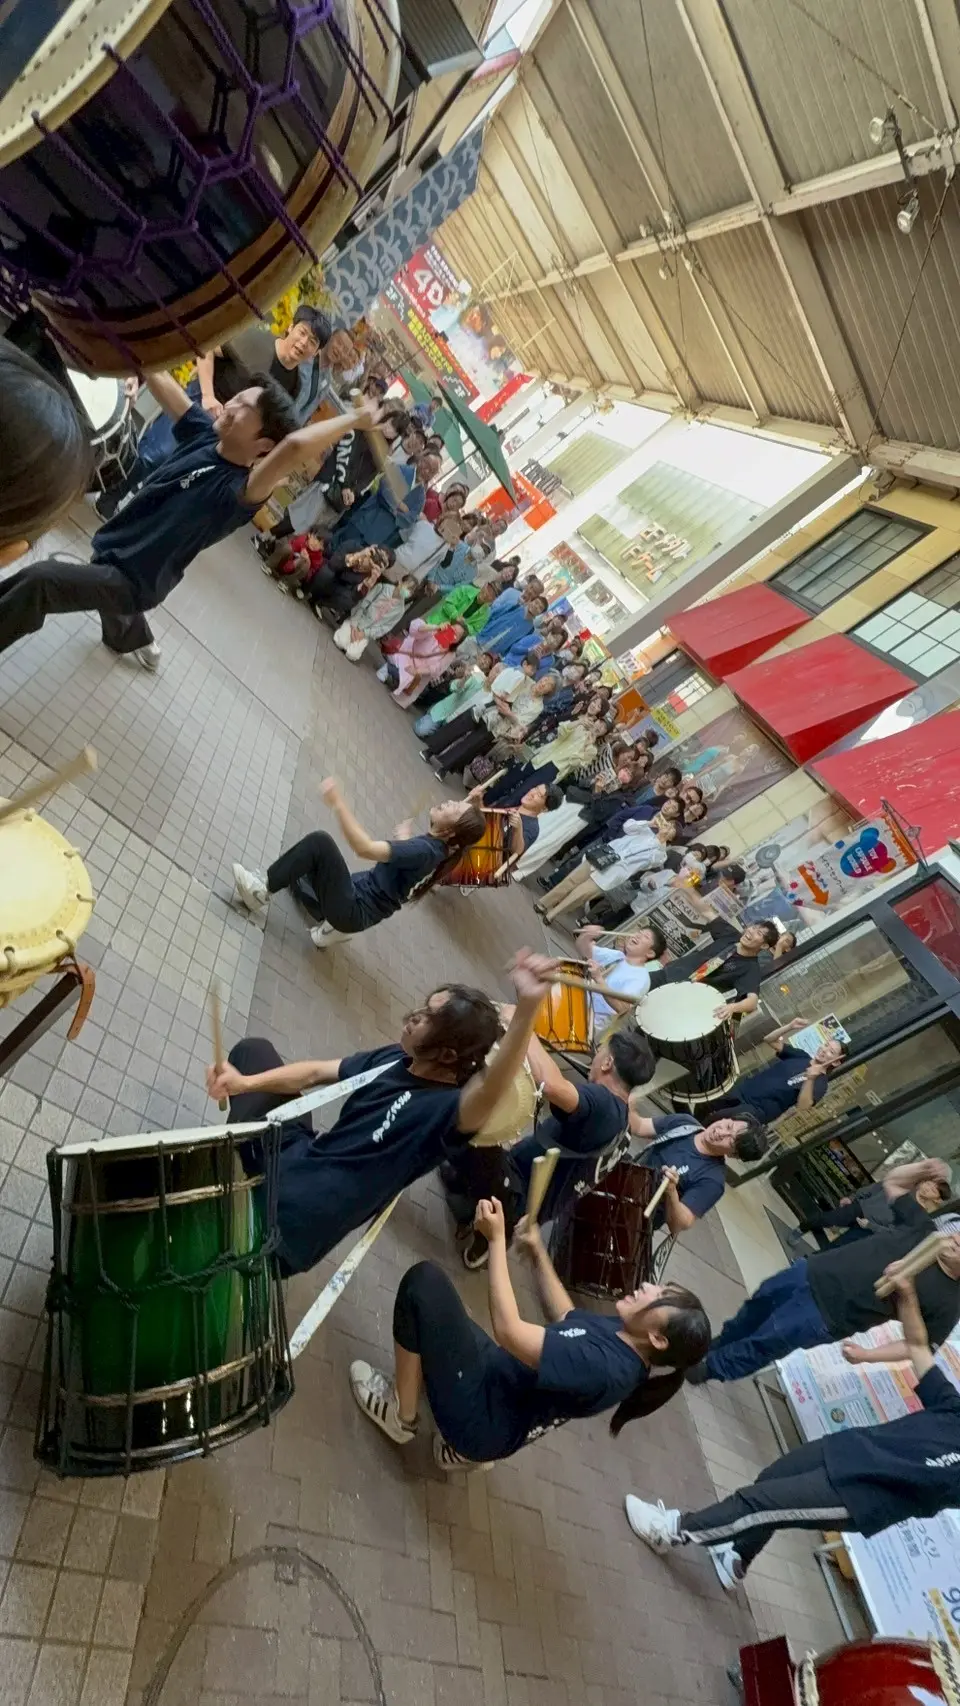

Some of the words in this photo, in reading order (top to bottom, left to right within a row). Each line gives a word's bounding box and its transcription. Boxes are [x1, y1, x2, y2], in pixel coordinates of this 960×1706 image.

[846, 853, 862, 874] WORLD
[854, 846, 874, 872] CAPSULE
[867, 846, 879, 860] TOY
